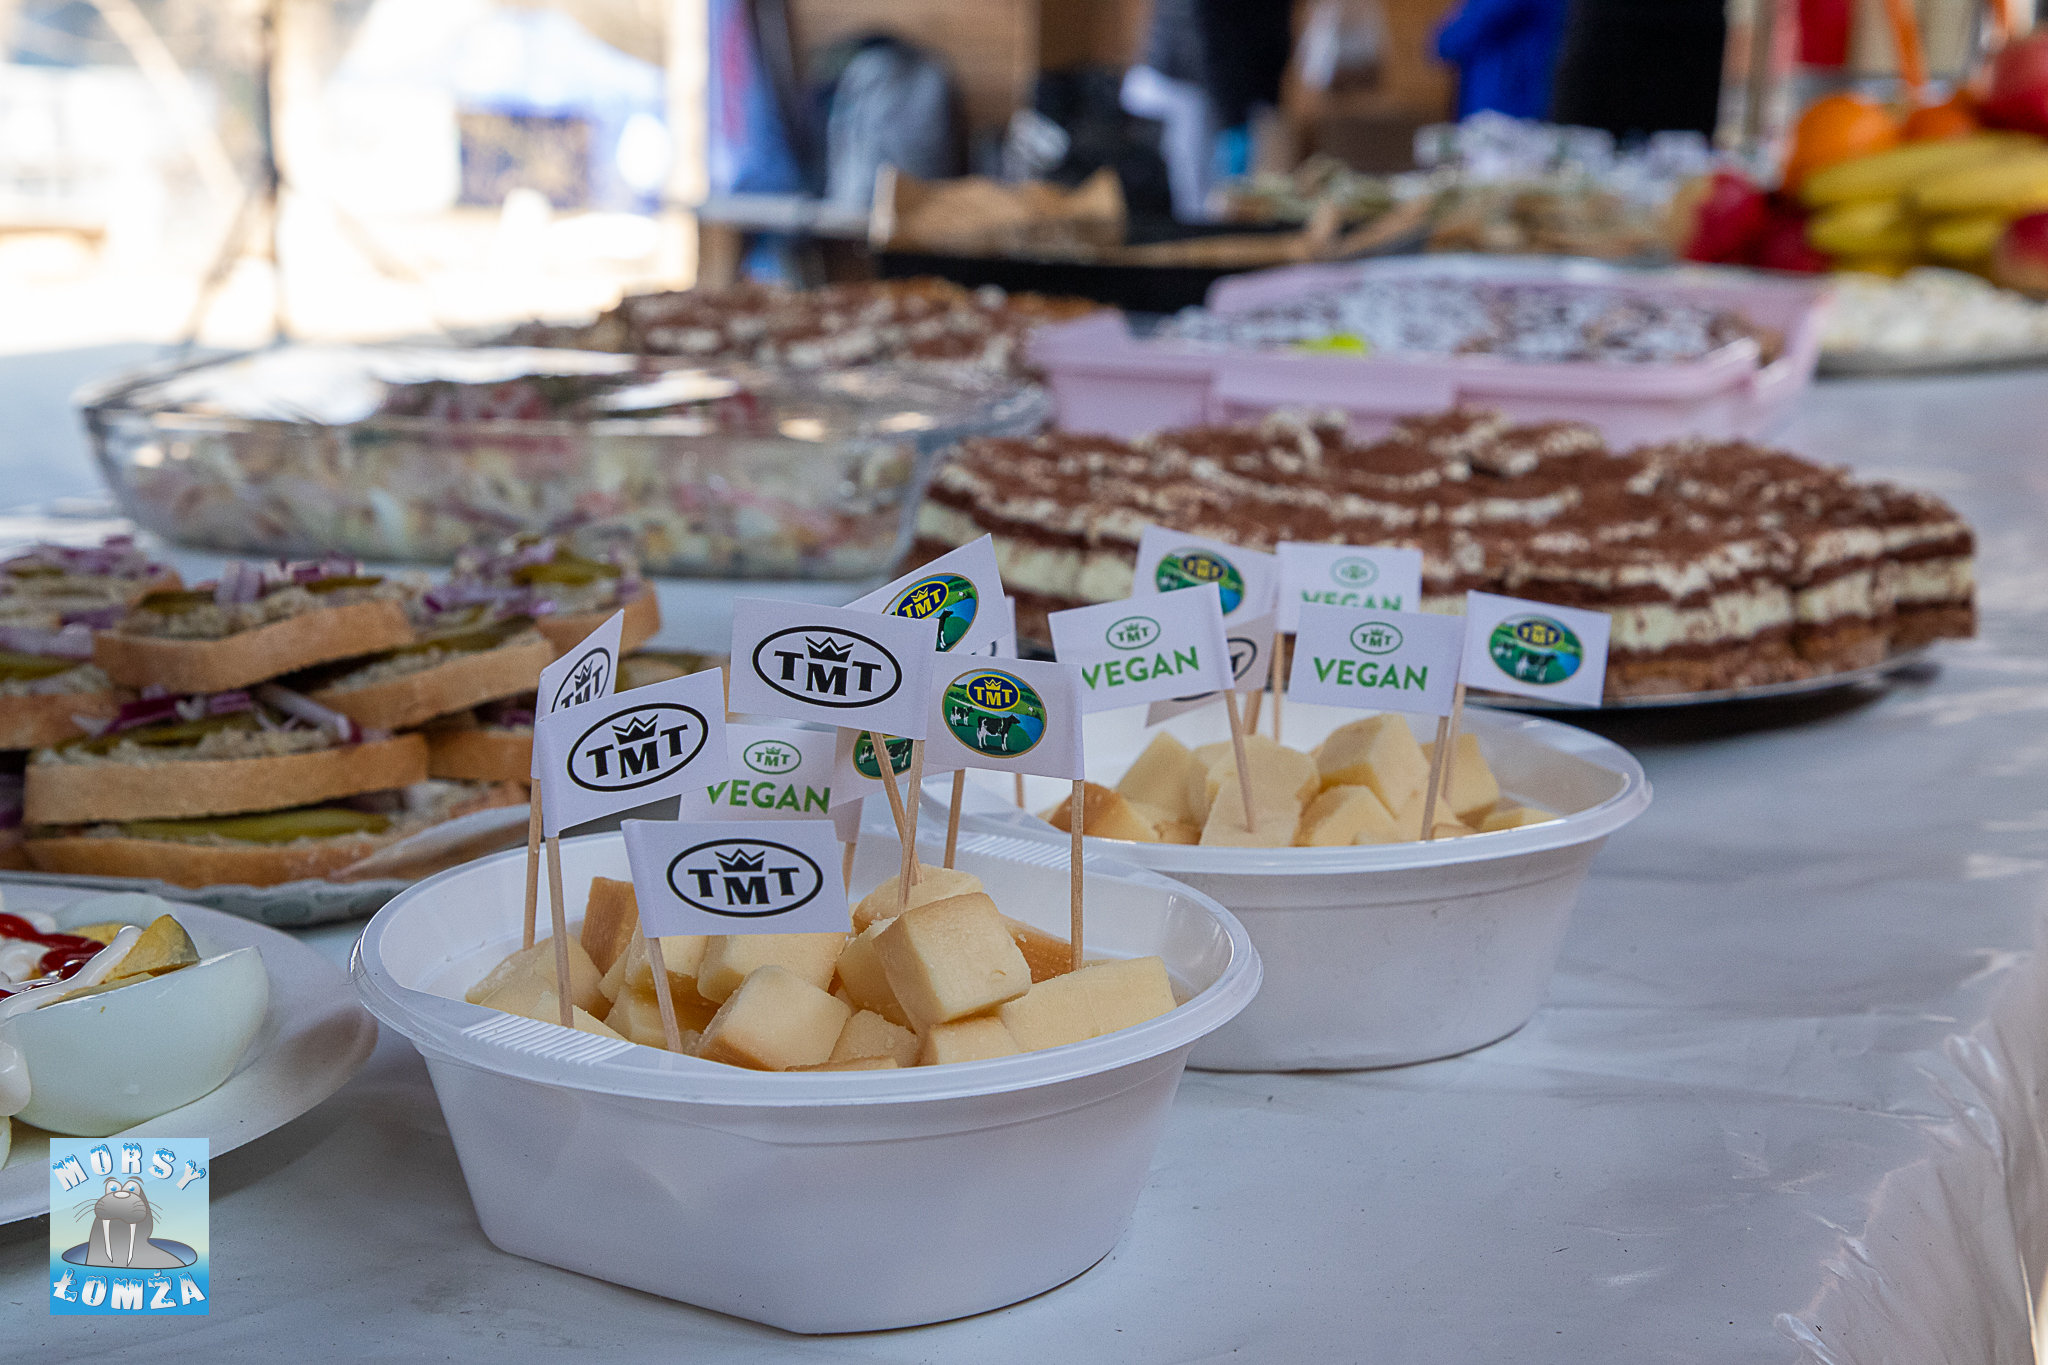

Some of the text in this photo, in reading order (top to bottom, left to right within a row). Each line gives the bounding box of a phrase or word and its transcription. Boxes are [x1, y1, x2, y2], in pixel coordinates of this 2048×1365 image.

[901, 588, 942, 619] TMT
[1116, 625, 1150, 643] TMT
[1360, 632, 1394, 648] TMT
[773, 650, 882, 697] TMT
[1081, 645, 1200, 691] VEGAN
[1313, 656, 1428, 692] VEGAN
[973, 686, 1013, 706] TMT
[585, 723, 689, 779] TMT
[754, 751, 791, 767] TMT
[706, 779, 831, 815] VEGAN
[687, 866, 800, 906] TMT
